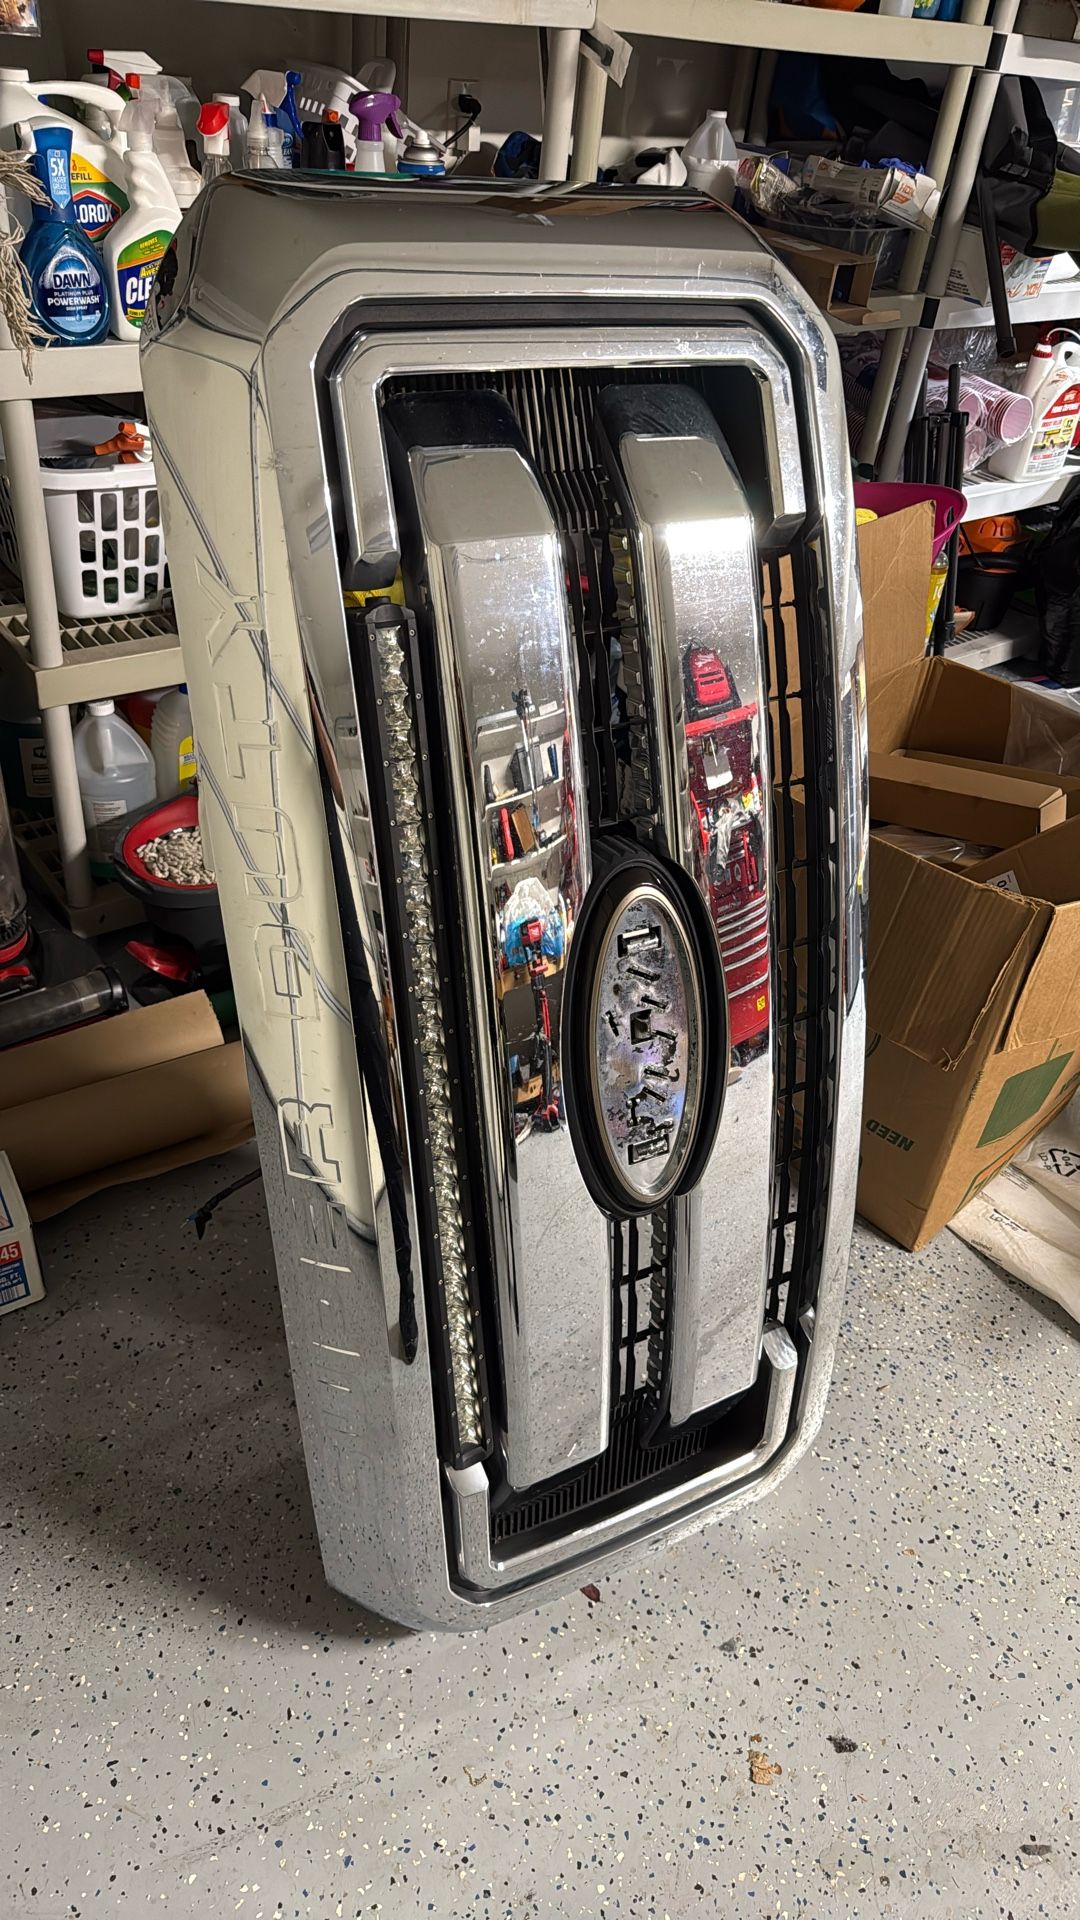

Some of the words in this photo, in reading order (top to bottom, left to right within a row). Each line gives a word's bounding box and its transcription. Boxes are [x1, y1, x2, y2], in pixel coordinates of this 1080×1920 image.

[50, 157, 66, 177] 5X
[71, 172, 92, 181] EFILL
[74, 203, 113, 223] LOROX
[53, 272, 91, 289] DAWN
[125, 275, 156, 305] CLE
[47, 295, 101, 307] POWERWASH
[193, 555, 323, 1020] DUTY
[866, 1119, 915, 1152] NEED
[1061, 1156, 1073, 1166] 04
